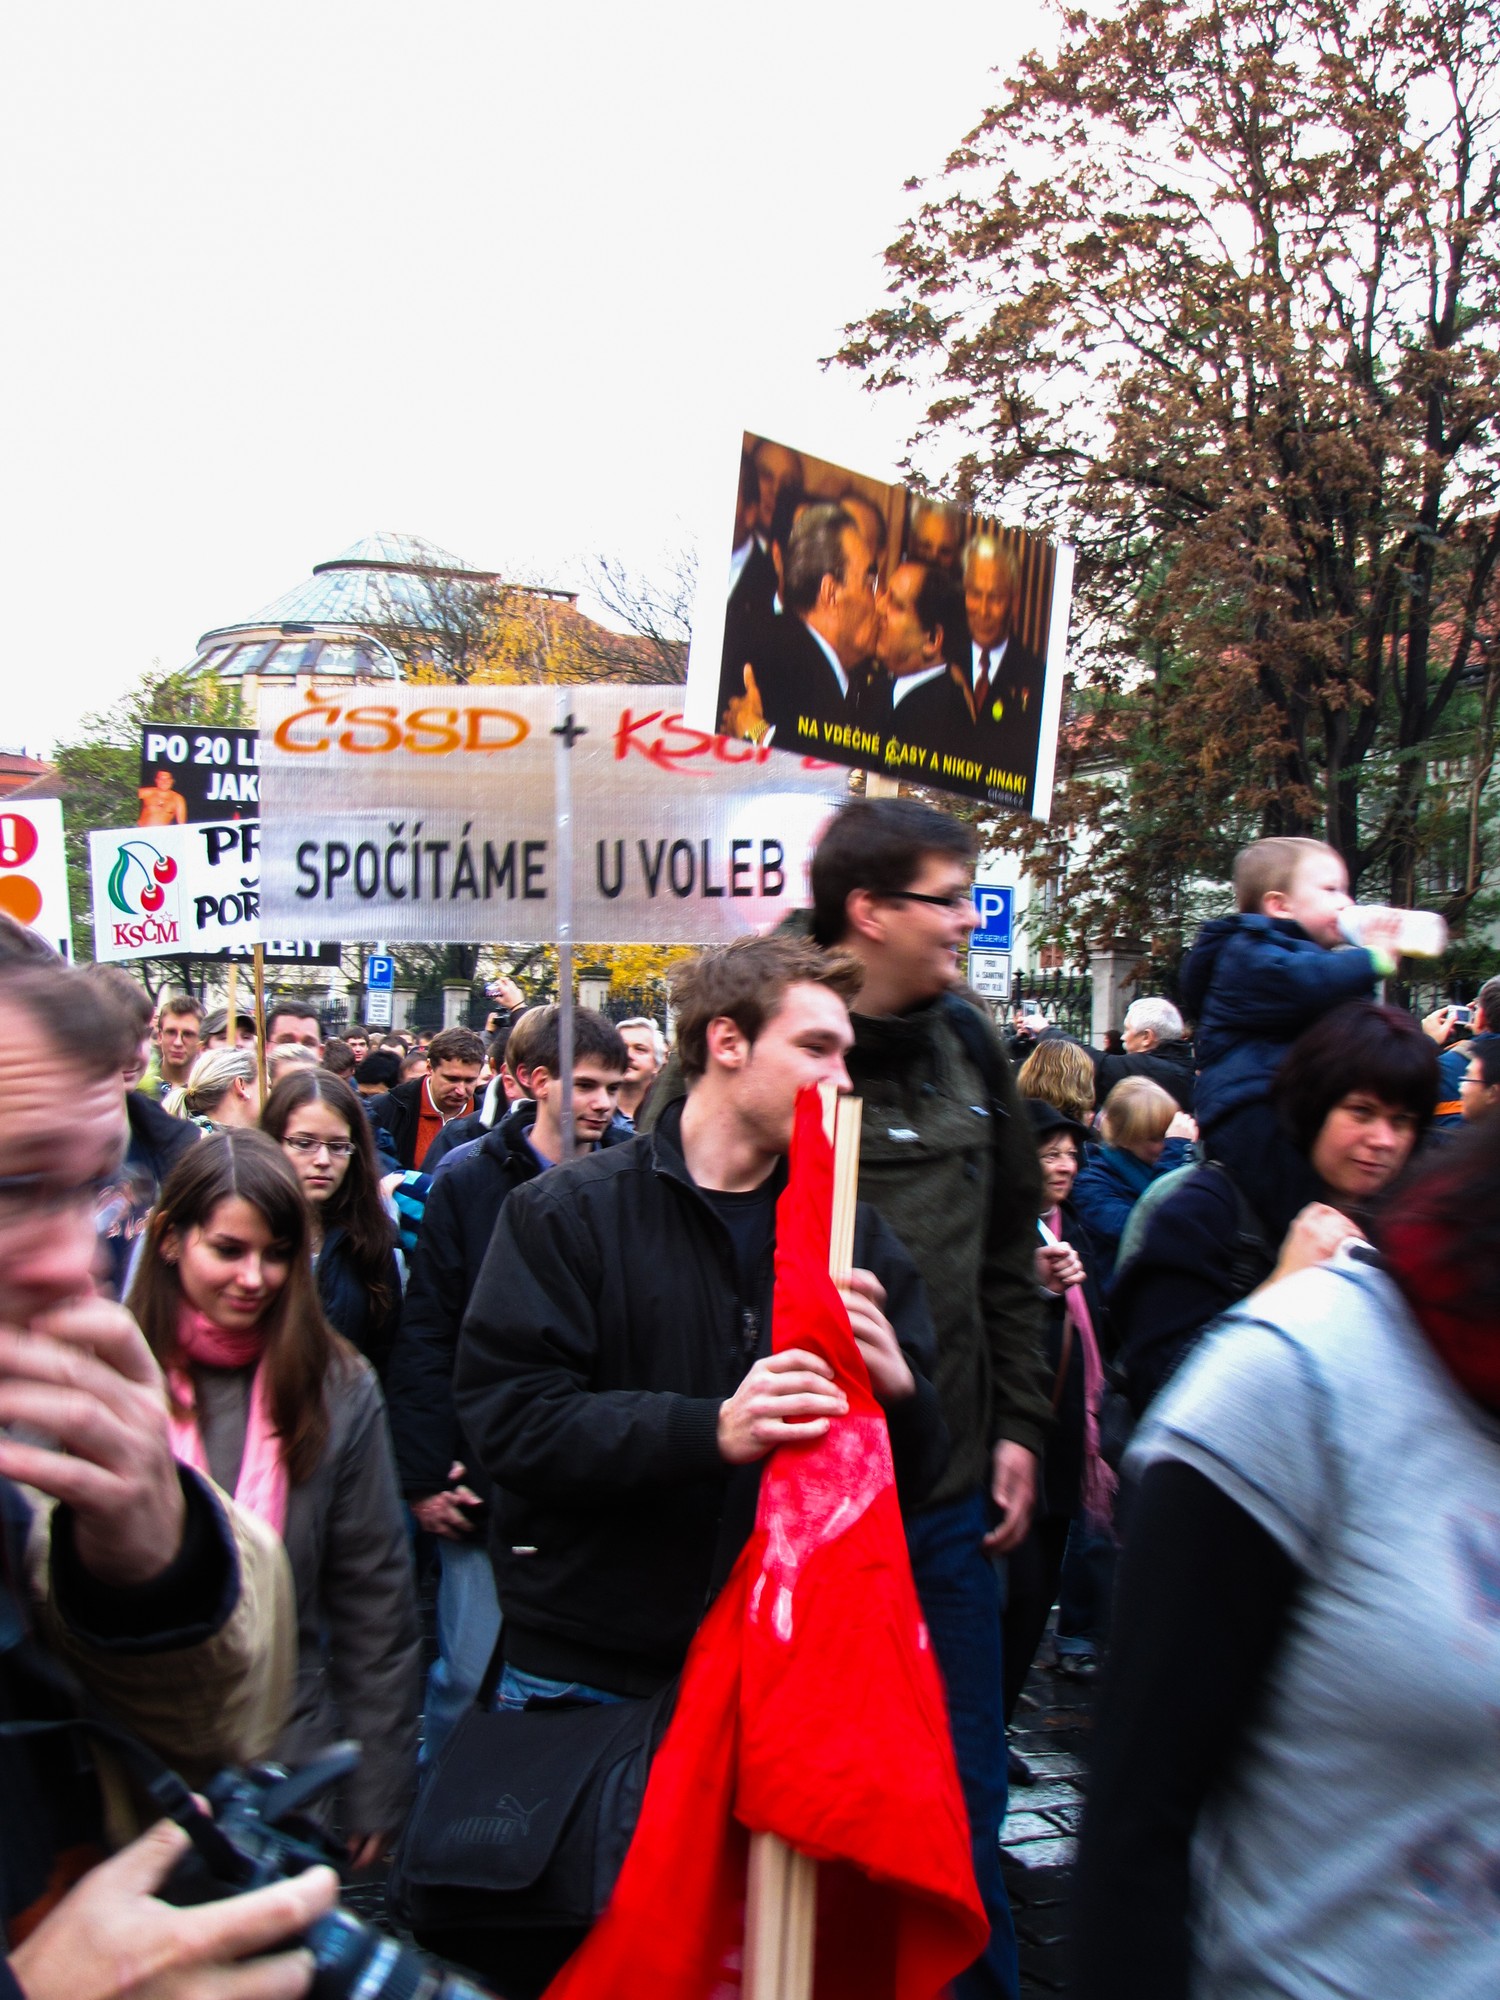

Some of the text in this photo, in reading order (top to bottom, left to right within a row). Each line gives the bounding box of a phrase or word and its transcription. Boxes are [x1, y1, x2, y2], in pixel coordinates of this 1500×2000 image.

[273, 688, 531, 755] ČSSD
[147, 734, 189, 764] PO
[194, 736, 230, 765] 20
[797, 715, 819, 740] NA
[929, 750, 939, 773] A
[943, 754, 983, 783] NIKDY
[207, 773, 260, 801] JAK
[295, 821, 549, 901] SPOČÍTÁME
[638, 838, 786, 898] VOLEB
[980, 893, 1005, 930] P
[112, 914, 181, 948] KSČM
[373, 960, 388, 979] P
